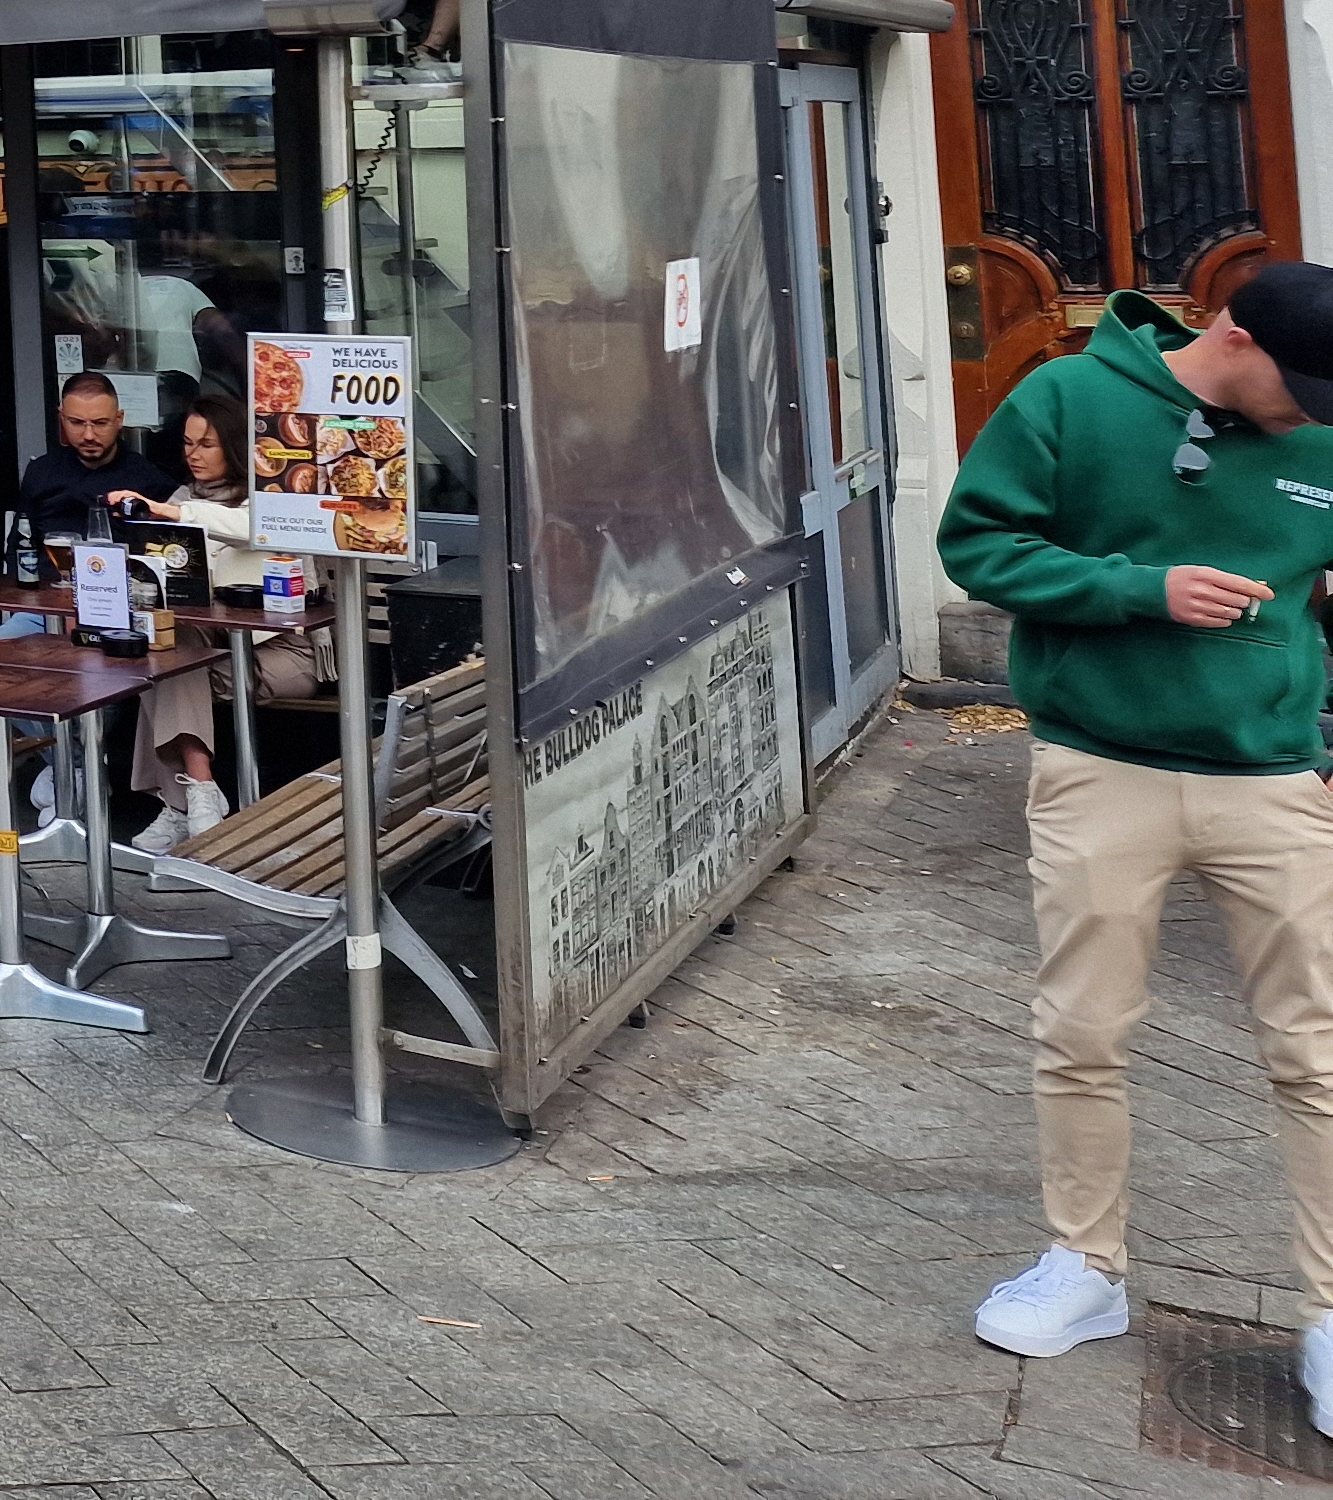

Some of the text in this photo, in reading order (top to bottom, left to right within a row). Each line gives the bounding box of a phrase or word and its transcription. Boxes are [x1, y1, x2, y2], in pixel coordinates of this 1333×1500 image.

[332, 347, 387, 358] WE HAVE
[332, 358, 398, 369] DELICIOUS
[330, 374, 402, 406] FOOD
[1275, 478, 1333, 502] REPRESE
[262, 516, 286, 524] CHECK
[307, 518, 323, 526] OUR
[280, 525, 301, 533] MENU
[303, 526, 327, 534] INSIDE
[523, 682, 643, 788] HE BULLDOG PALACE
